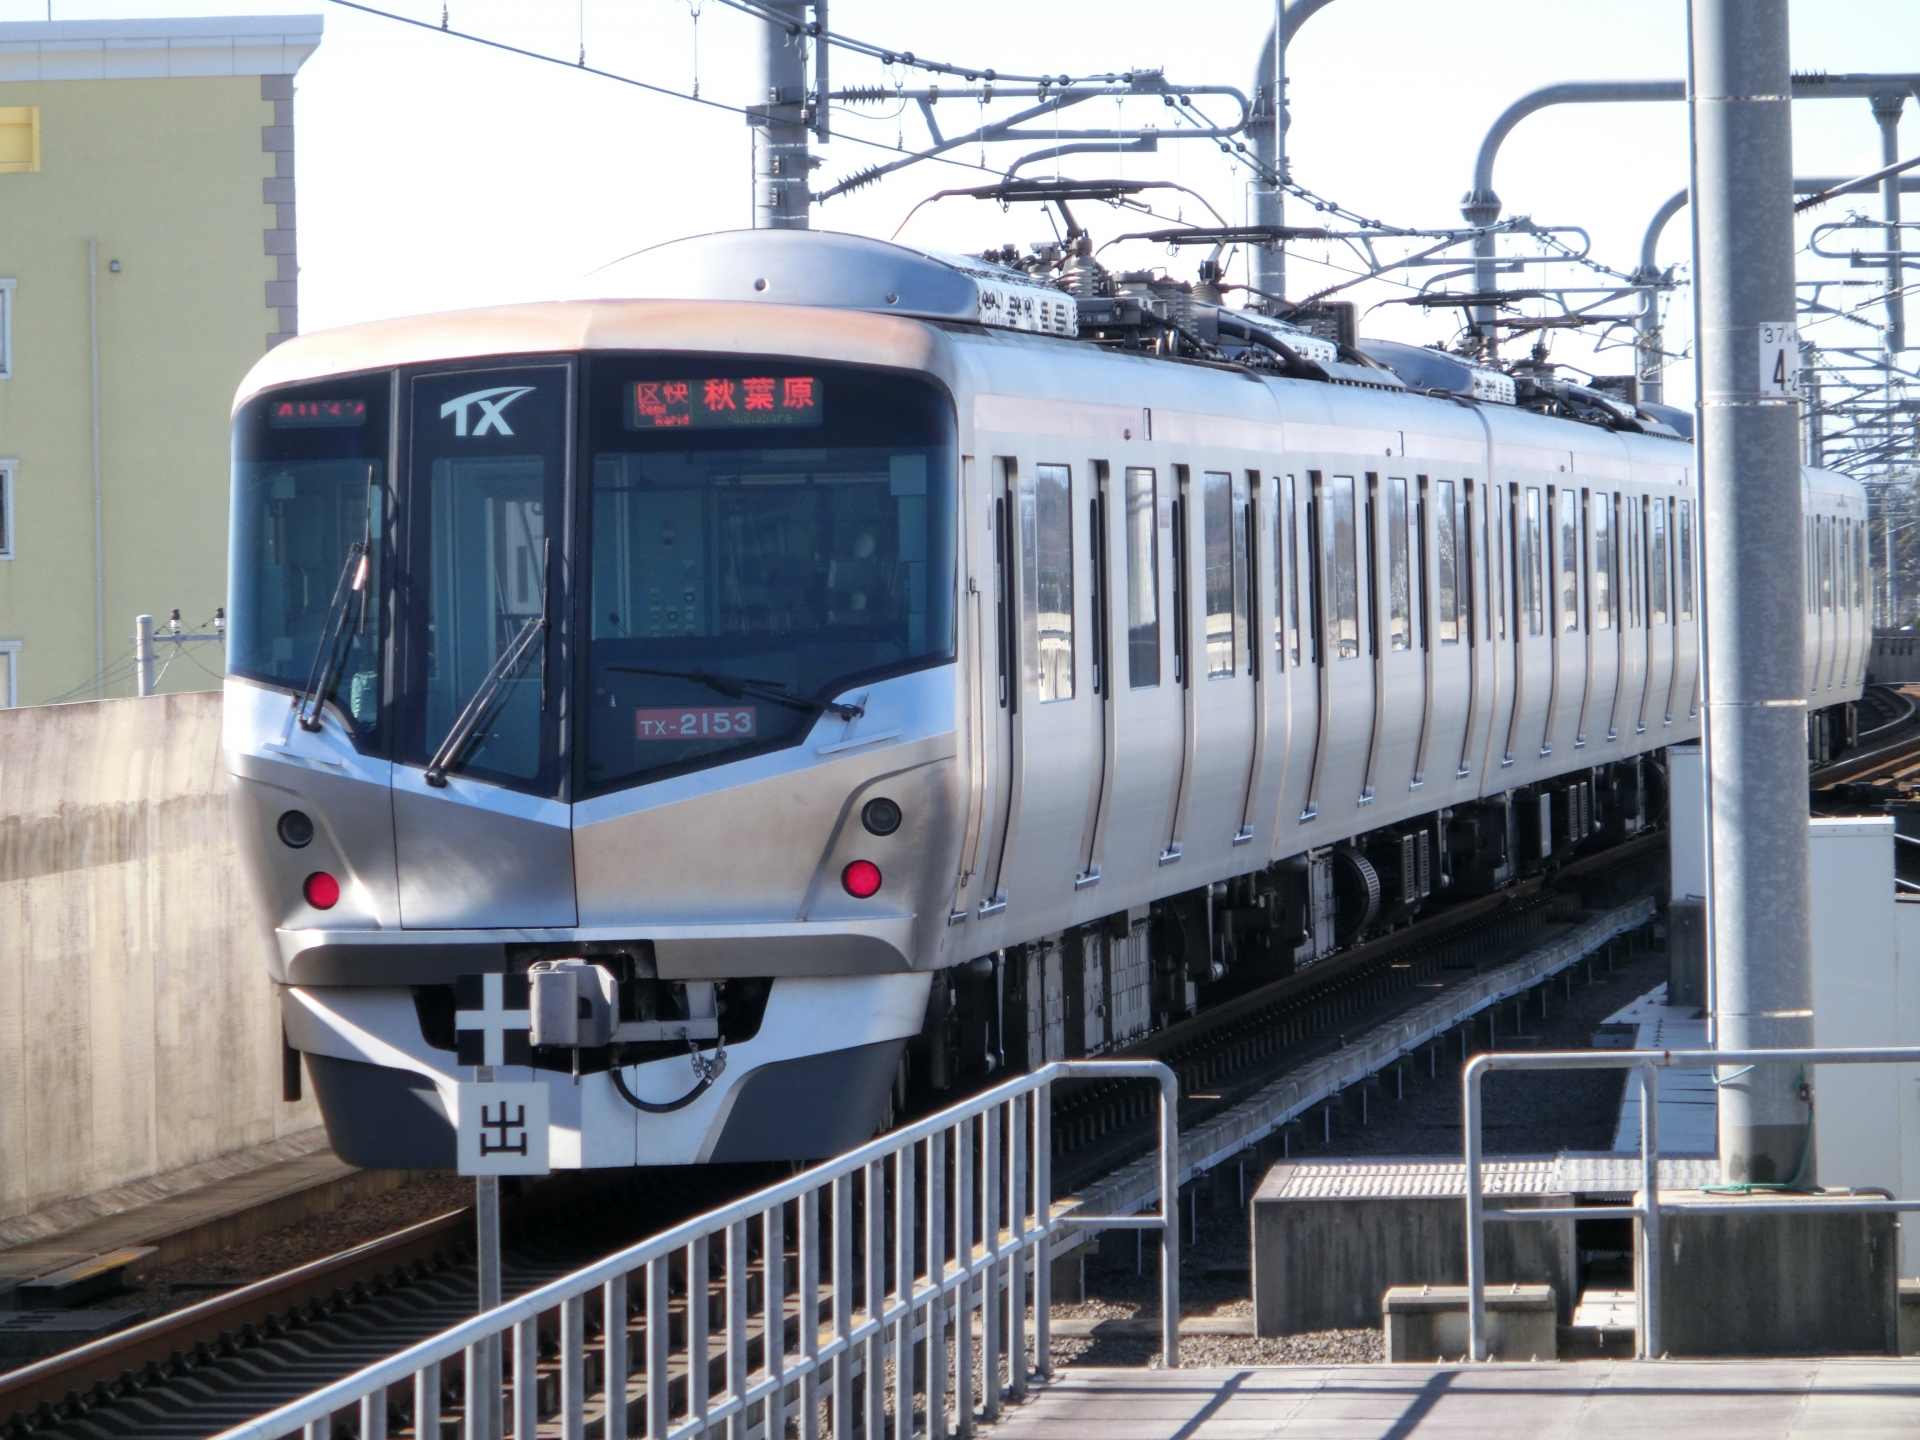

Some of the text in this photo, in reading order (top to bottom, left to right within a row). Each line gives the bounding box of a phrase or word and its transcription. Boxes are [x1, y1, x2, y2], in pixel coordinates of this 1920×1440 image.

[637, 382, 688, 404] 区快
[703, 377, 814, 411] 秋葉原
[441, 386, 537, 436] TX
[640, 712, 752, 735] TX-2153
[480, 1101, 527, 1157] 出
